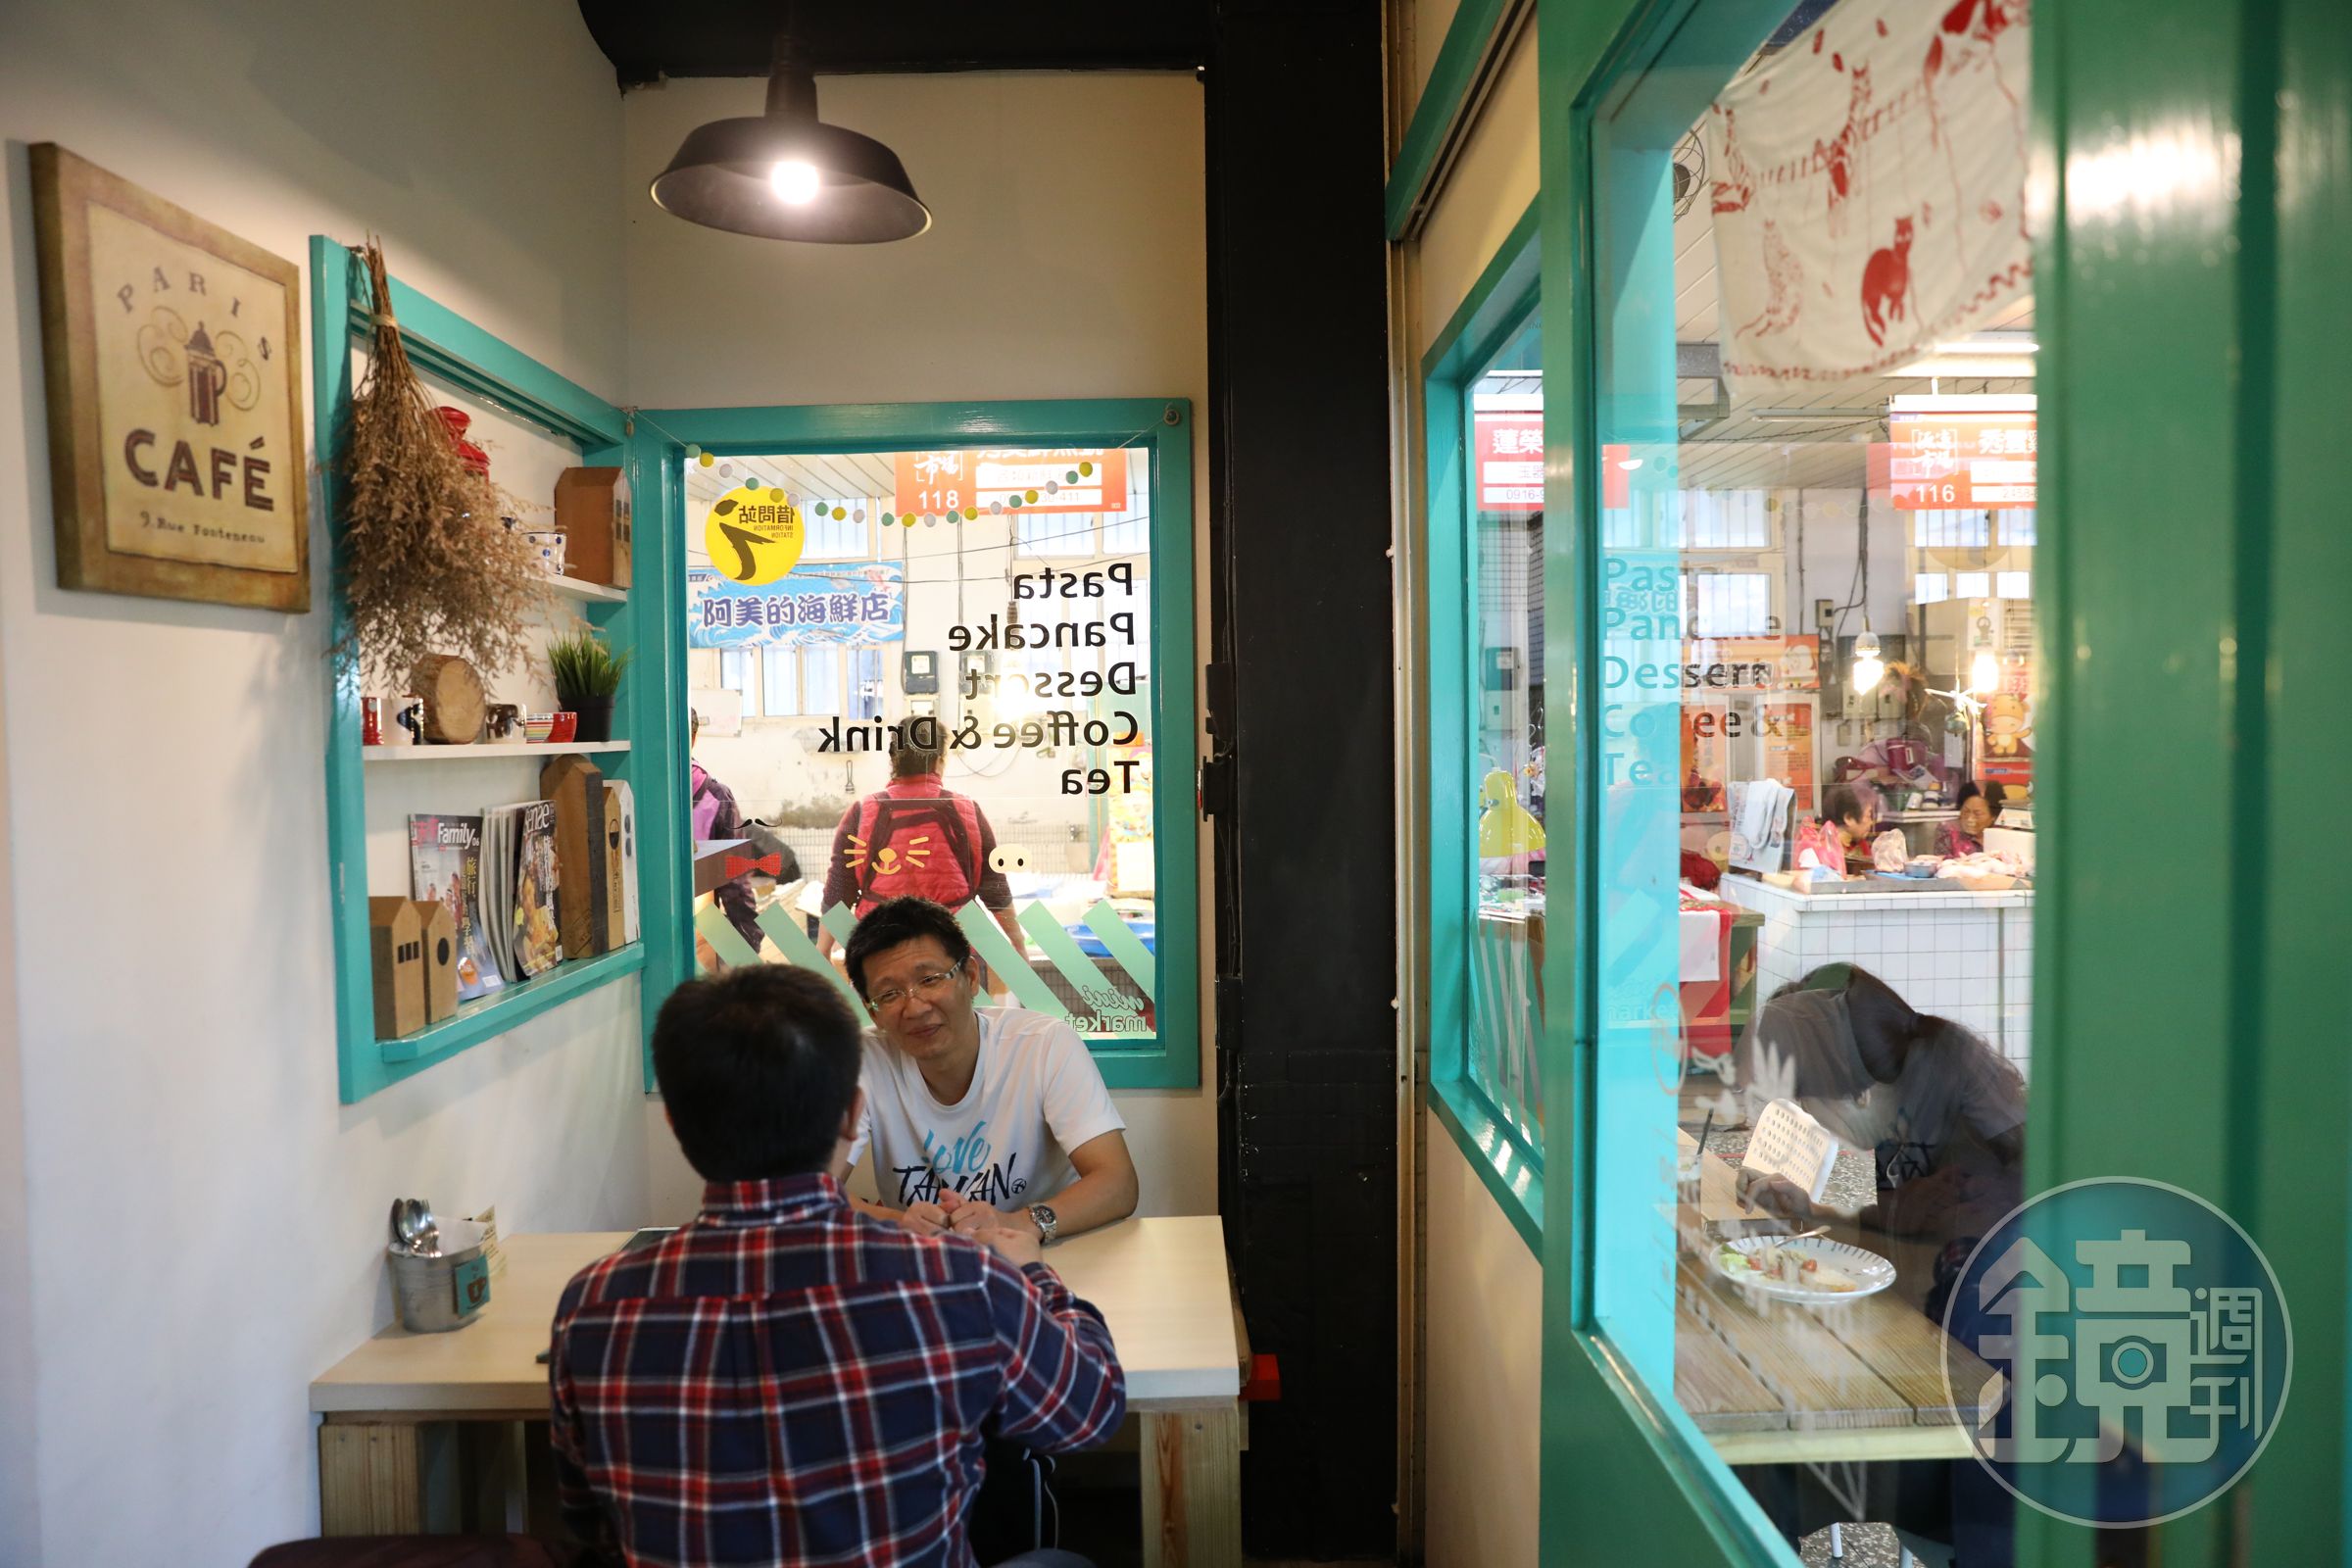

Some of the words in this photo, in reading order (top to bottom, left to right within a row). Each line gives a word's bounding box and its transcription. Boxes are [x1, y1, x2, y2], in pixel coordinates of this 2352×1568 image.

[117, 266, 272, 362] PARIS
[124, 429, 275, 512] CAFÉ
[918, 490, 959, 510] 118
[1916, 484, 1956, 503] 116
[703, 591, 890, 627] 阿美的海鮮店
[438, 822, 476, 851] Family
